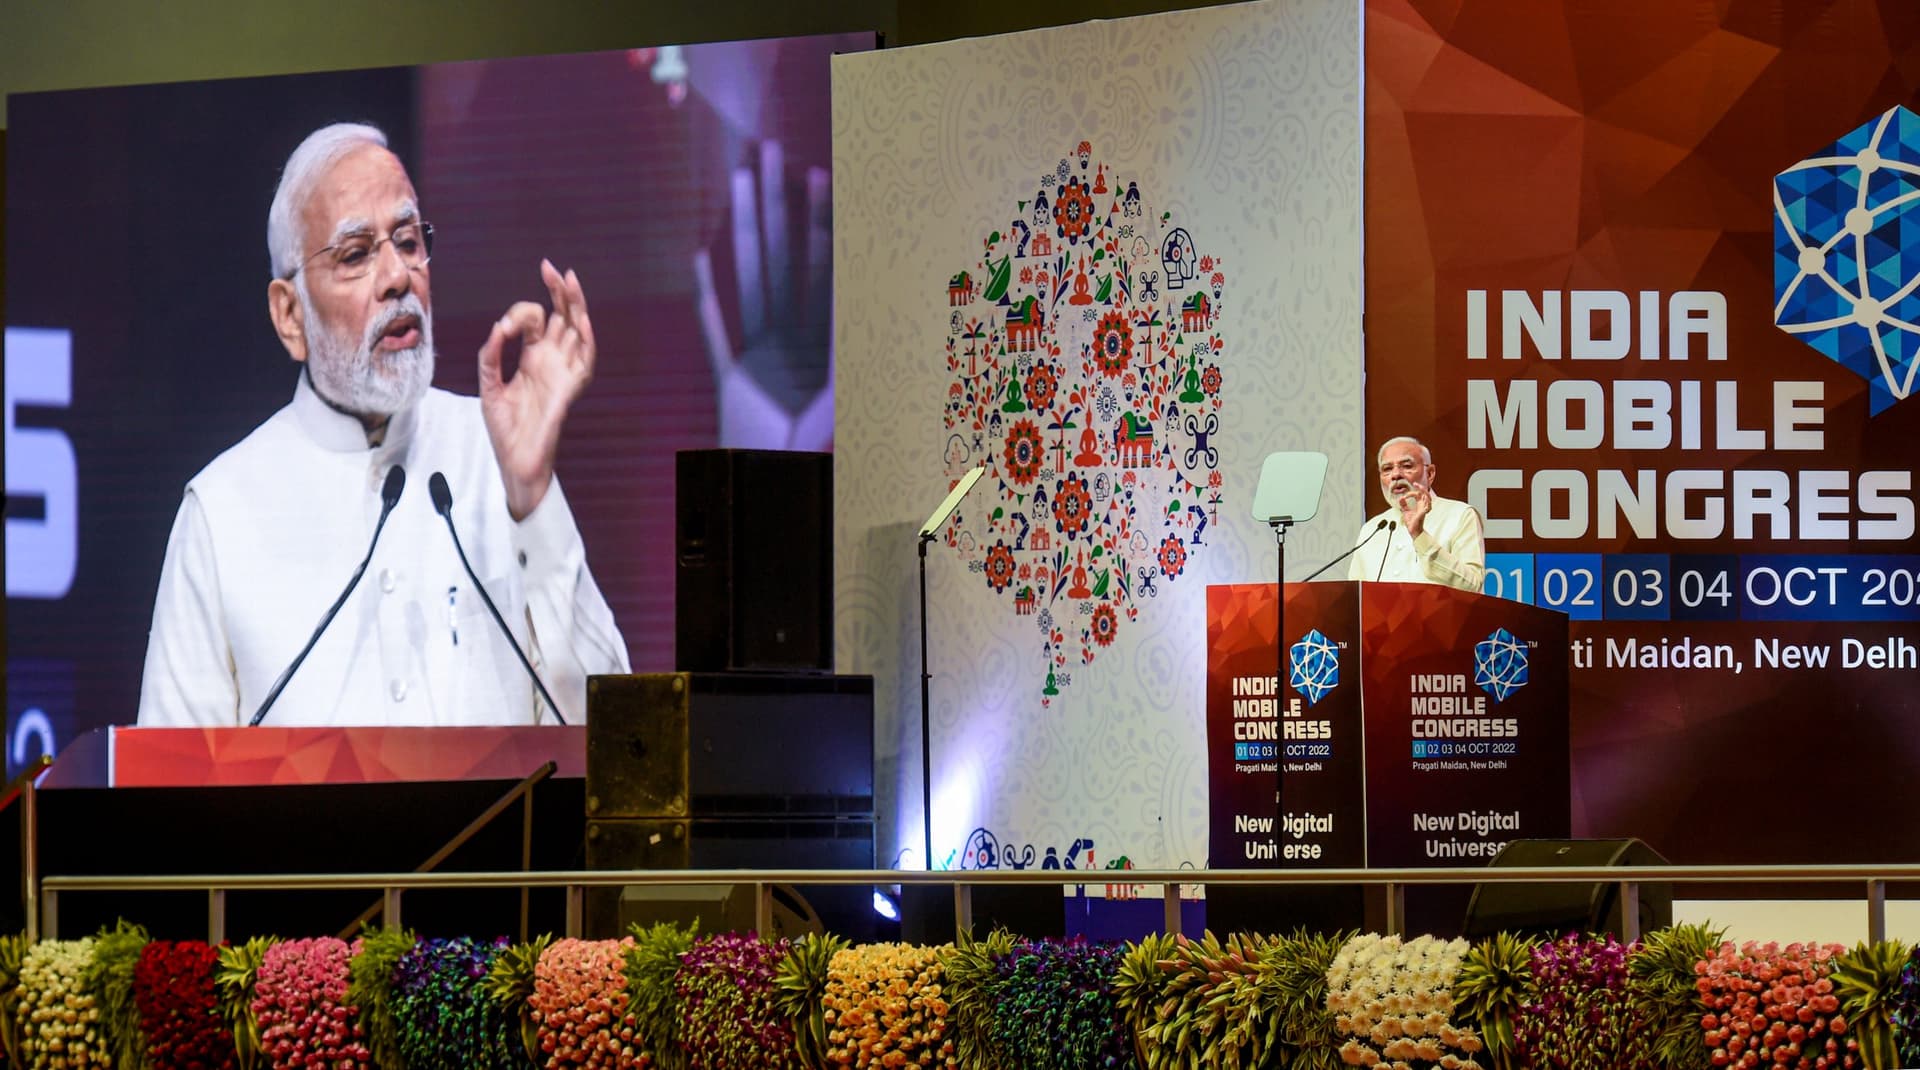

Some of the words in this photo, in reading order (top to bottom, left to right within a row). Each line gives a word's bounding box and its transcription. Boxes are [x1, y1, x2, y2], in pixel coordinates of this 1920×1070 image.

[1467, 290, 1727, 360] INDIA
[1468, 380, 1824, 450] MOBILE
[1544, 569, 1594, 605] 02
[1613, 569, 1663, 606] 03
[1680, 570, 1732, 607] 04
[1746, 567, 1847, 606] OCT
[1862, 569, 1920, 605] 20
[1607, 637, 1742, 674] Maidan,
[1755, 639, 1830, 668] New
[1411, 675, 1465, 692] INDIA
[1412, 697, 1485, 715] MOBILE
[1412, 719, 1518, 737] CONGRESS
[1237, 746, 1247, 756] 01
[1249, 746, 1259, 756] 02
[1262, 746, 1272, 756] 03
[1287, 745, 1306, 755] OCT
[1309, 745, 1329, 755] 2022
[1414, 744, 1424, 754] 01
[1428, 744, 1438, 754] 02
[1442, 744, 1452, 754] 03
[1455, 744, 1466, 754] 04
[1469, 743, 1490, 753] OCT
[1492, 743, 1515, 753] 2022
[1236, 764, 1260, 774] Pragati
[1289, 763, 1304, 771] New
[1305, 762, 1322, 771] Delhi
[1413, 761, 1438, 771] Pragati
[1441, 761, 1469, 770] Maidan,
[1471, 761, 1487, 769] New
[1489, 760, 1507, 769] Delhi
[1236, 815, 1273, 832] New
[1414, 814, 1454, 831] New
[1458, 810, 1519, 836] Digital
